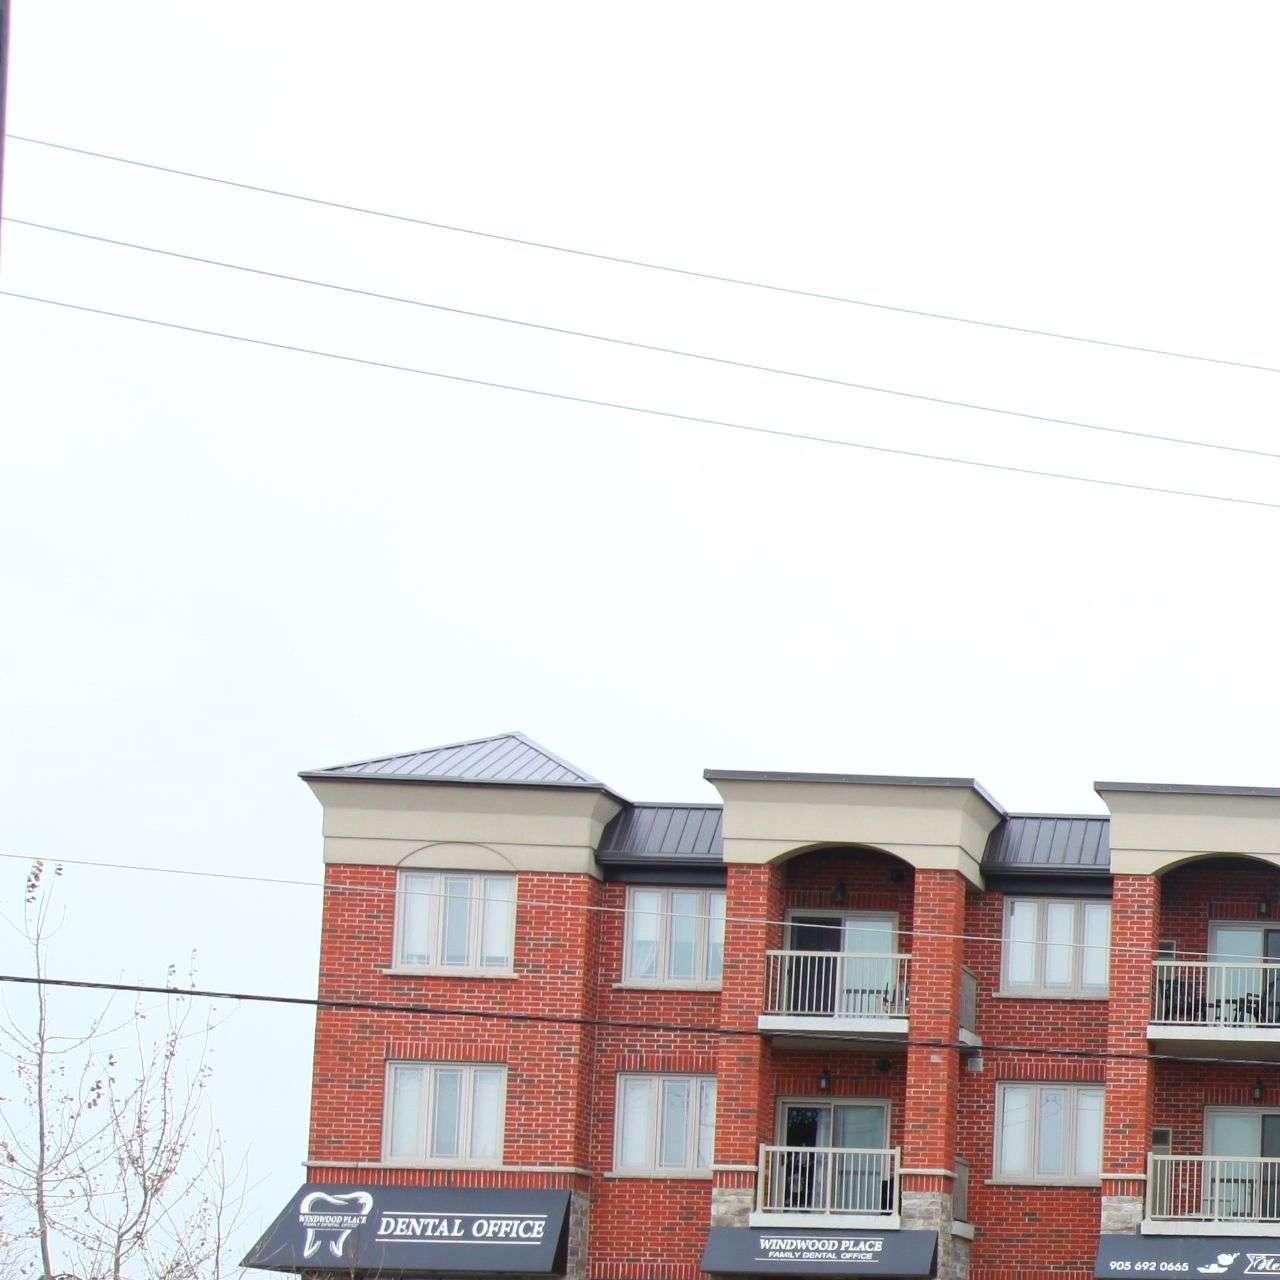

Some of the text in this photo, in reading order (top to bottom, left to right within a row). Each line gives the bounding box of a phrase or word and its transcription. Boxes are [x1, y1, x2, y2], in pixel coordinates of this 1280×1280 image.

[343, 1215, 367, 1224] PLACE
[377, 1217, 545, 1238] DENTAL OFFICE
[760, 1239, 883, 1252] WINDWOOD PLACE
[802, 1251, 837, 1259] DENTAL
[840, 1252, 873, 1260] OFFICE
[1109, 1261, 1189, 1272] 905 692 0665
